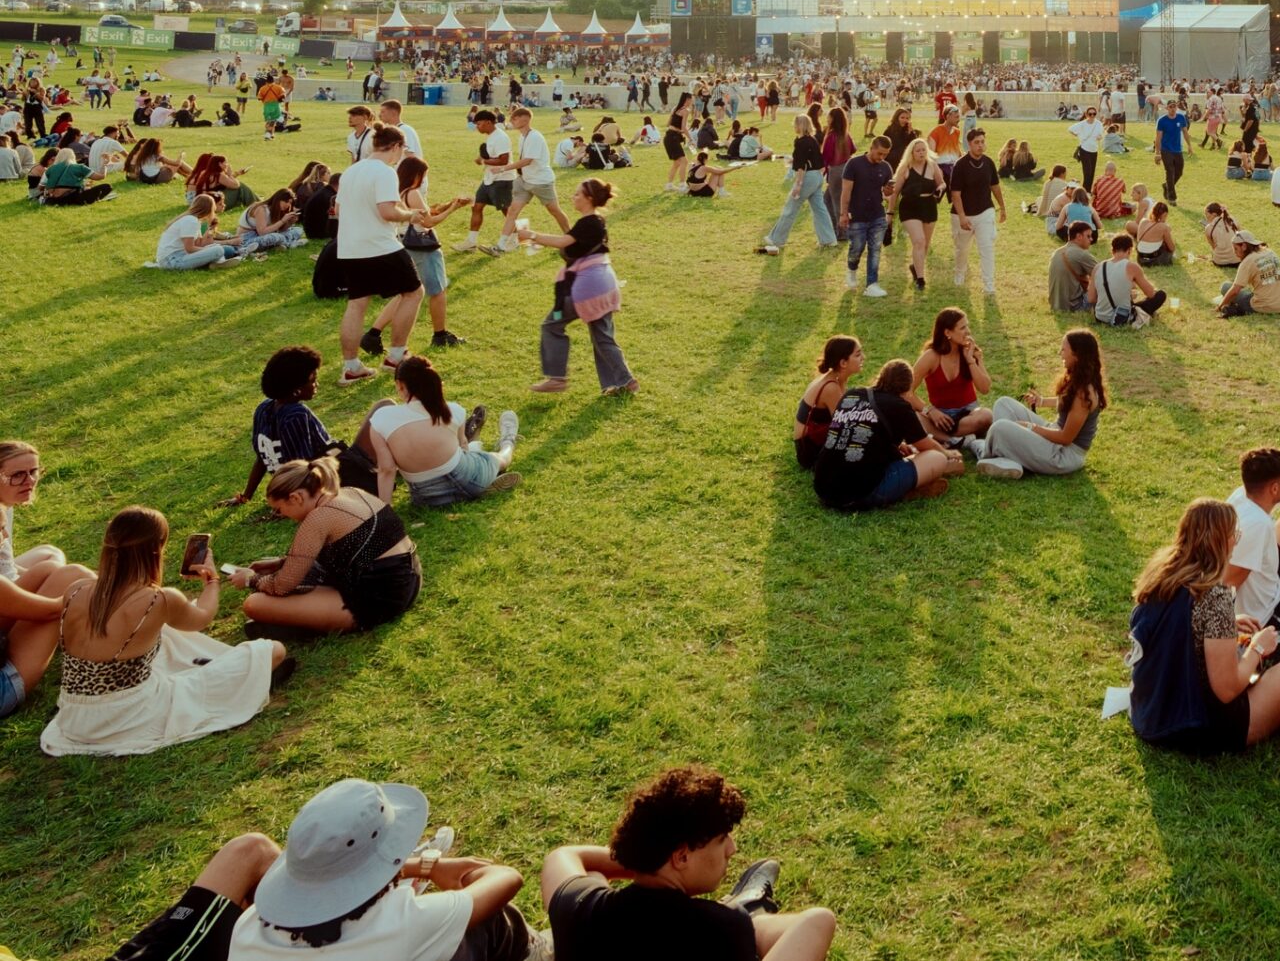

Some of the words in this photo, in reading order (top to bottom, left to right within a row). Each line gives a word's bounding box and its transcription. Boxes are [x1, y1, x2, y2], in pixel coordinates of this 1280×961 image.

[100, 29, 124, 42] Exit
[146, 33, 169, 44] Exit
[232, 37, 255, 49] Exit
[274, 39, 296, 52] Exit
